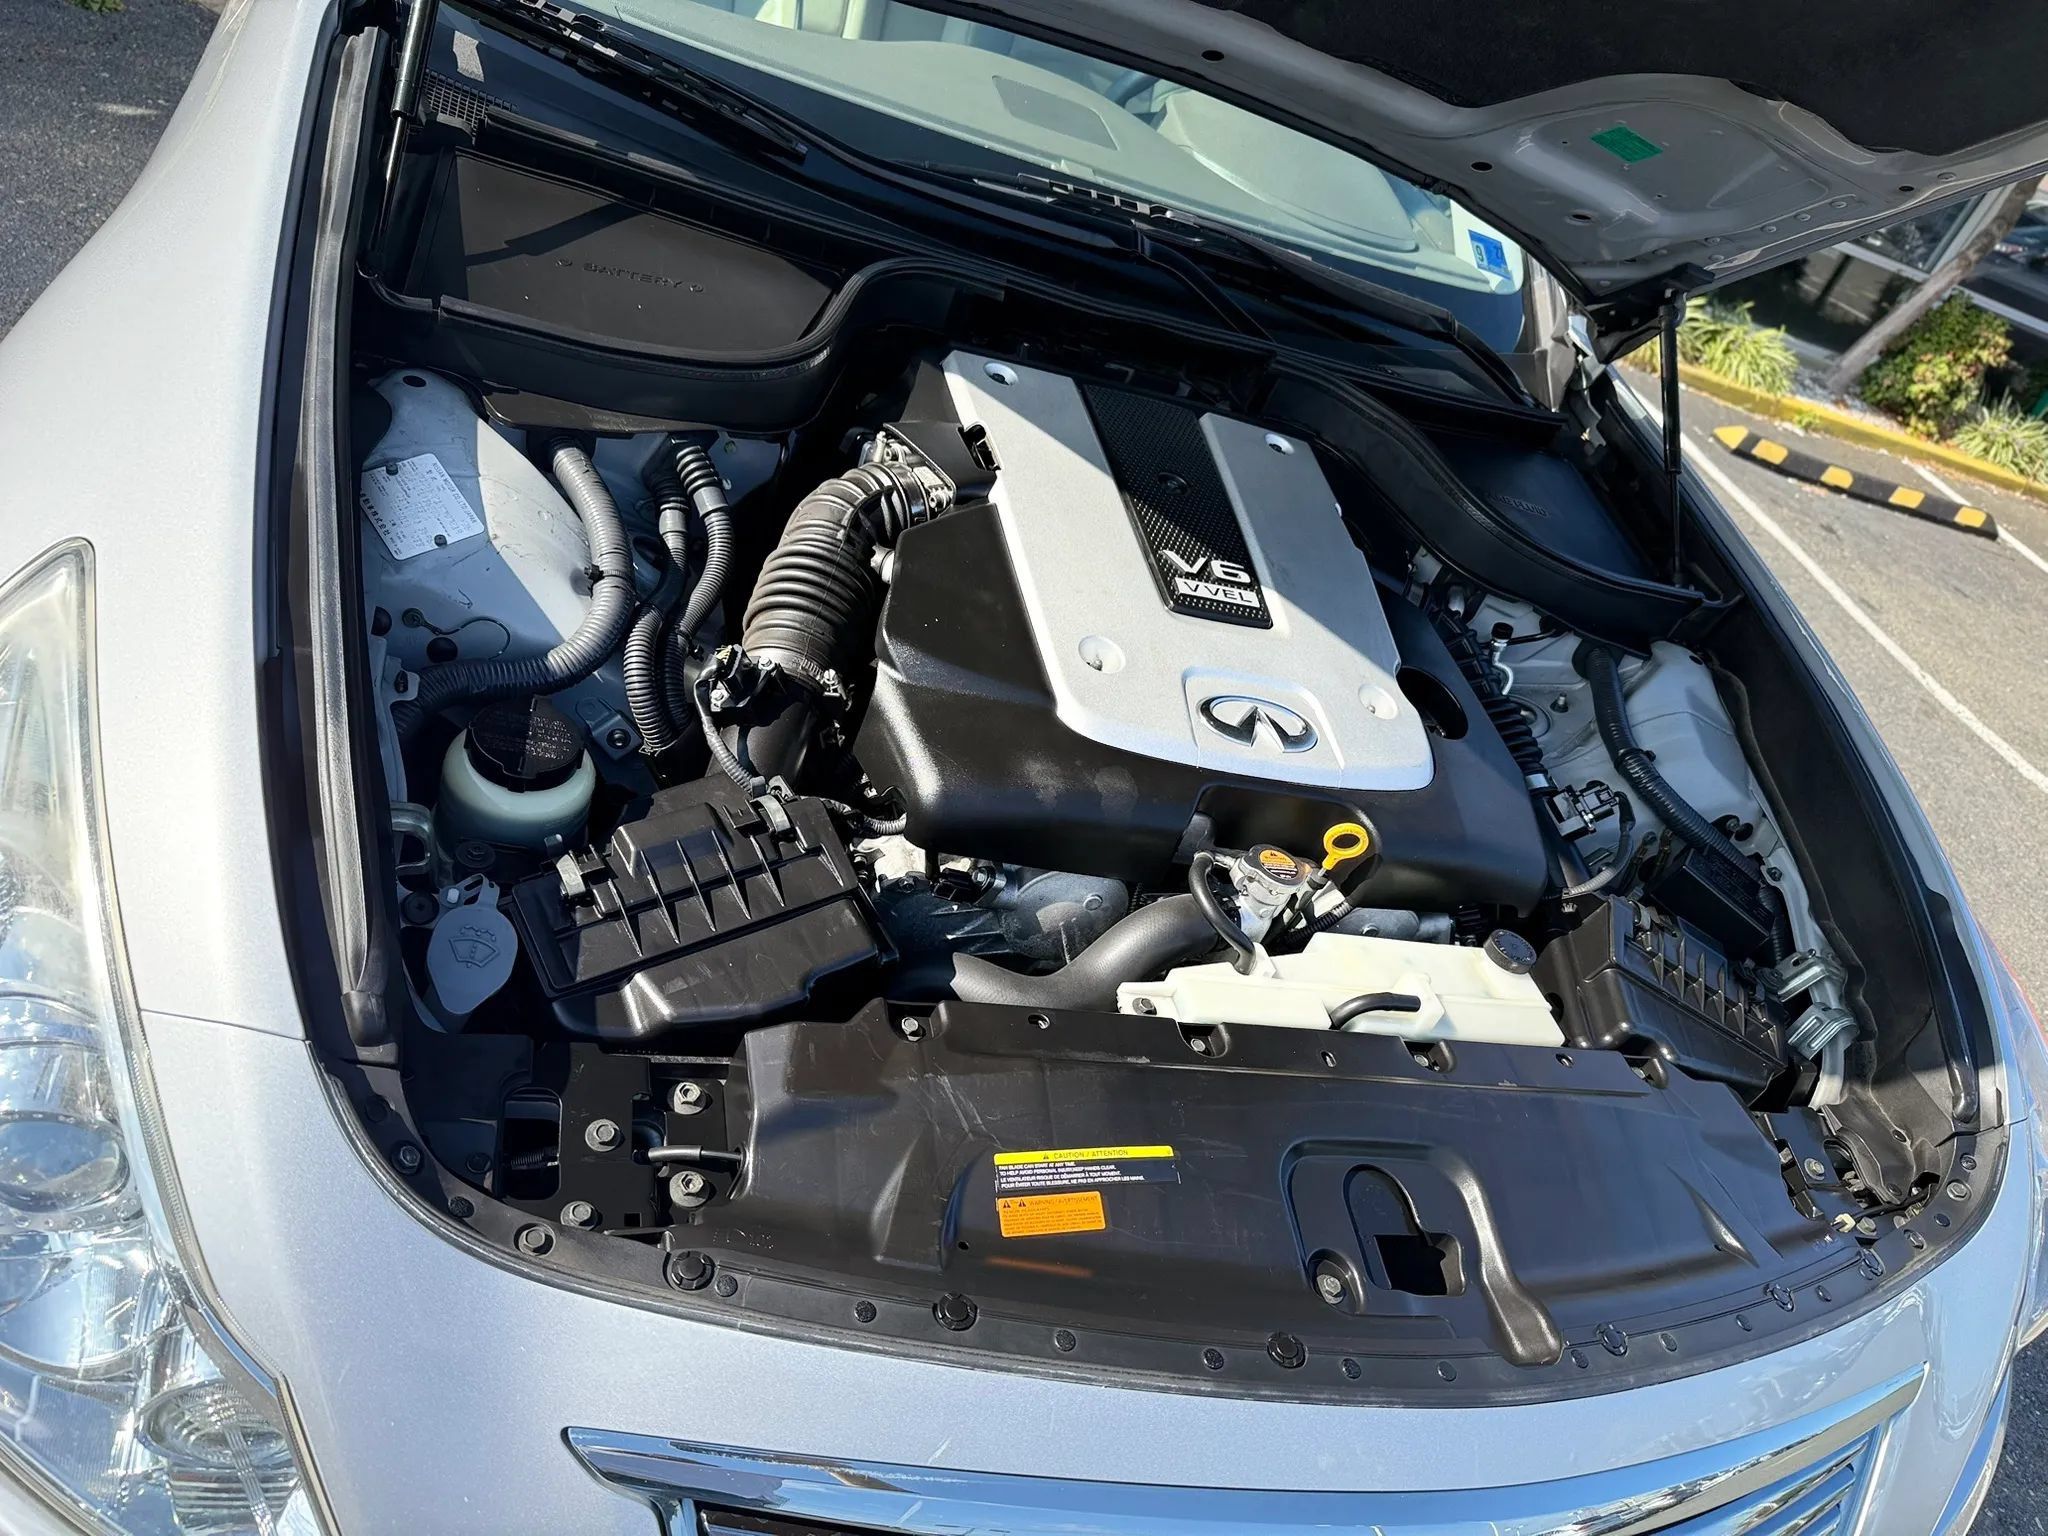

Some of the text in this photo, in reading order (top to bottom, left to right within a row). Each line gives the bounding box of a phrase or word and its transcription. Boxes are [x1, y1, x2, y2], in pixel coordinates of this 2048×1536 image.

[583, 262, 683, 288] BATTERY
[1161, 549, 1251, 584] V6
[1183, 581, 1253, 603] VVEL
[1053, 1151, 1084, 1159] CAUTION
[1092, 1149, 1129, 1157] ATTENTION
